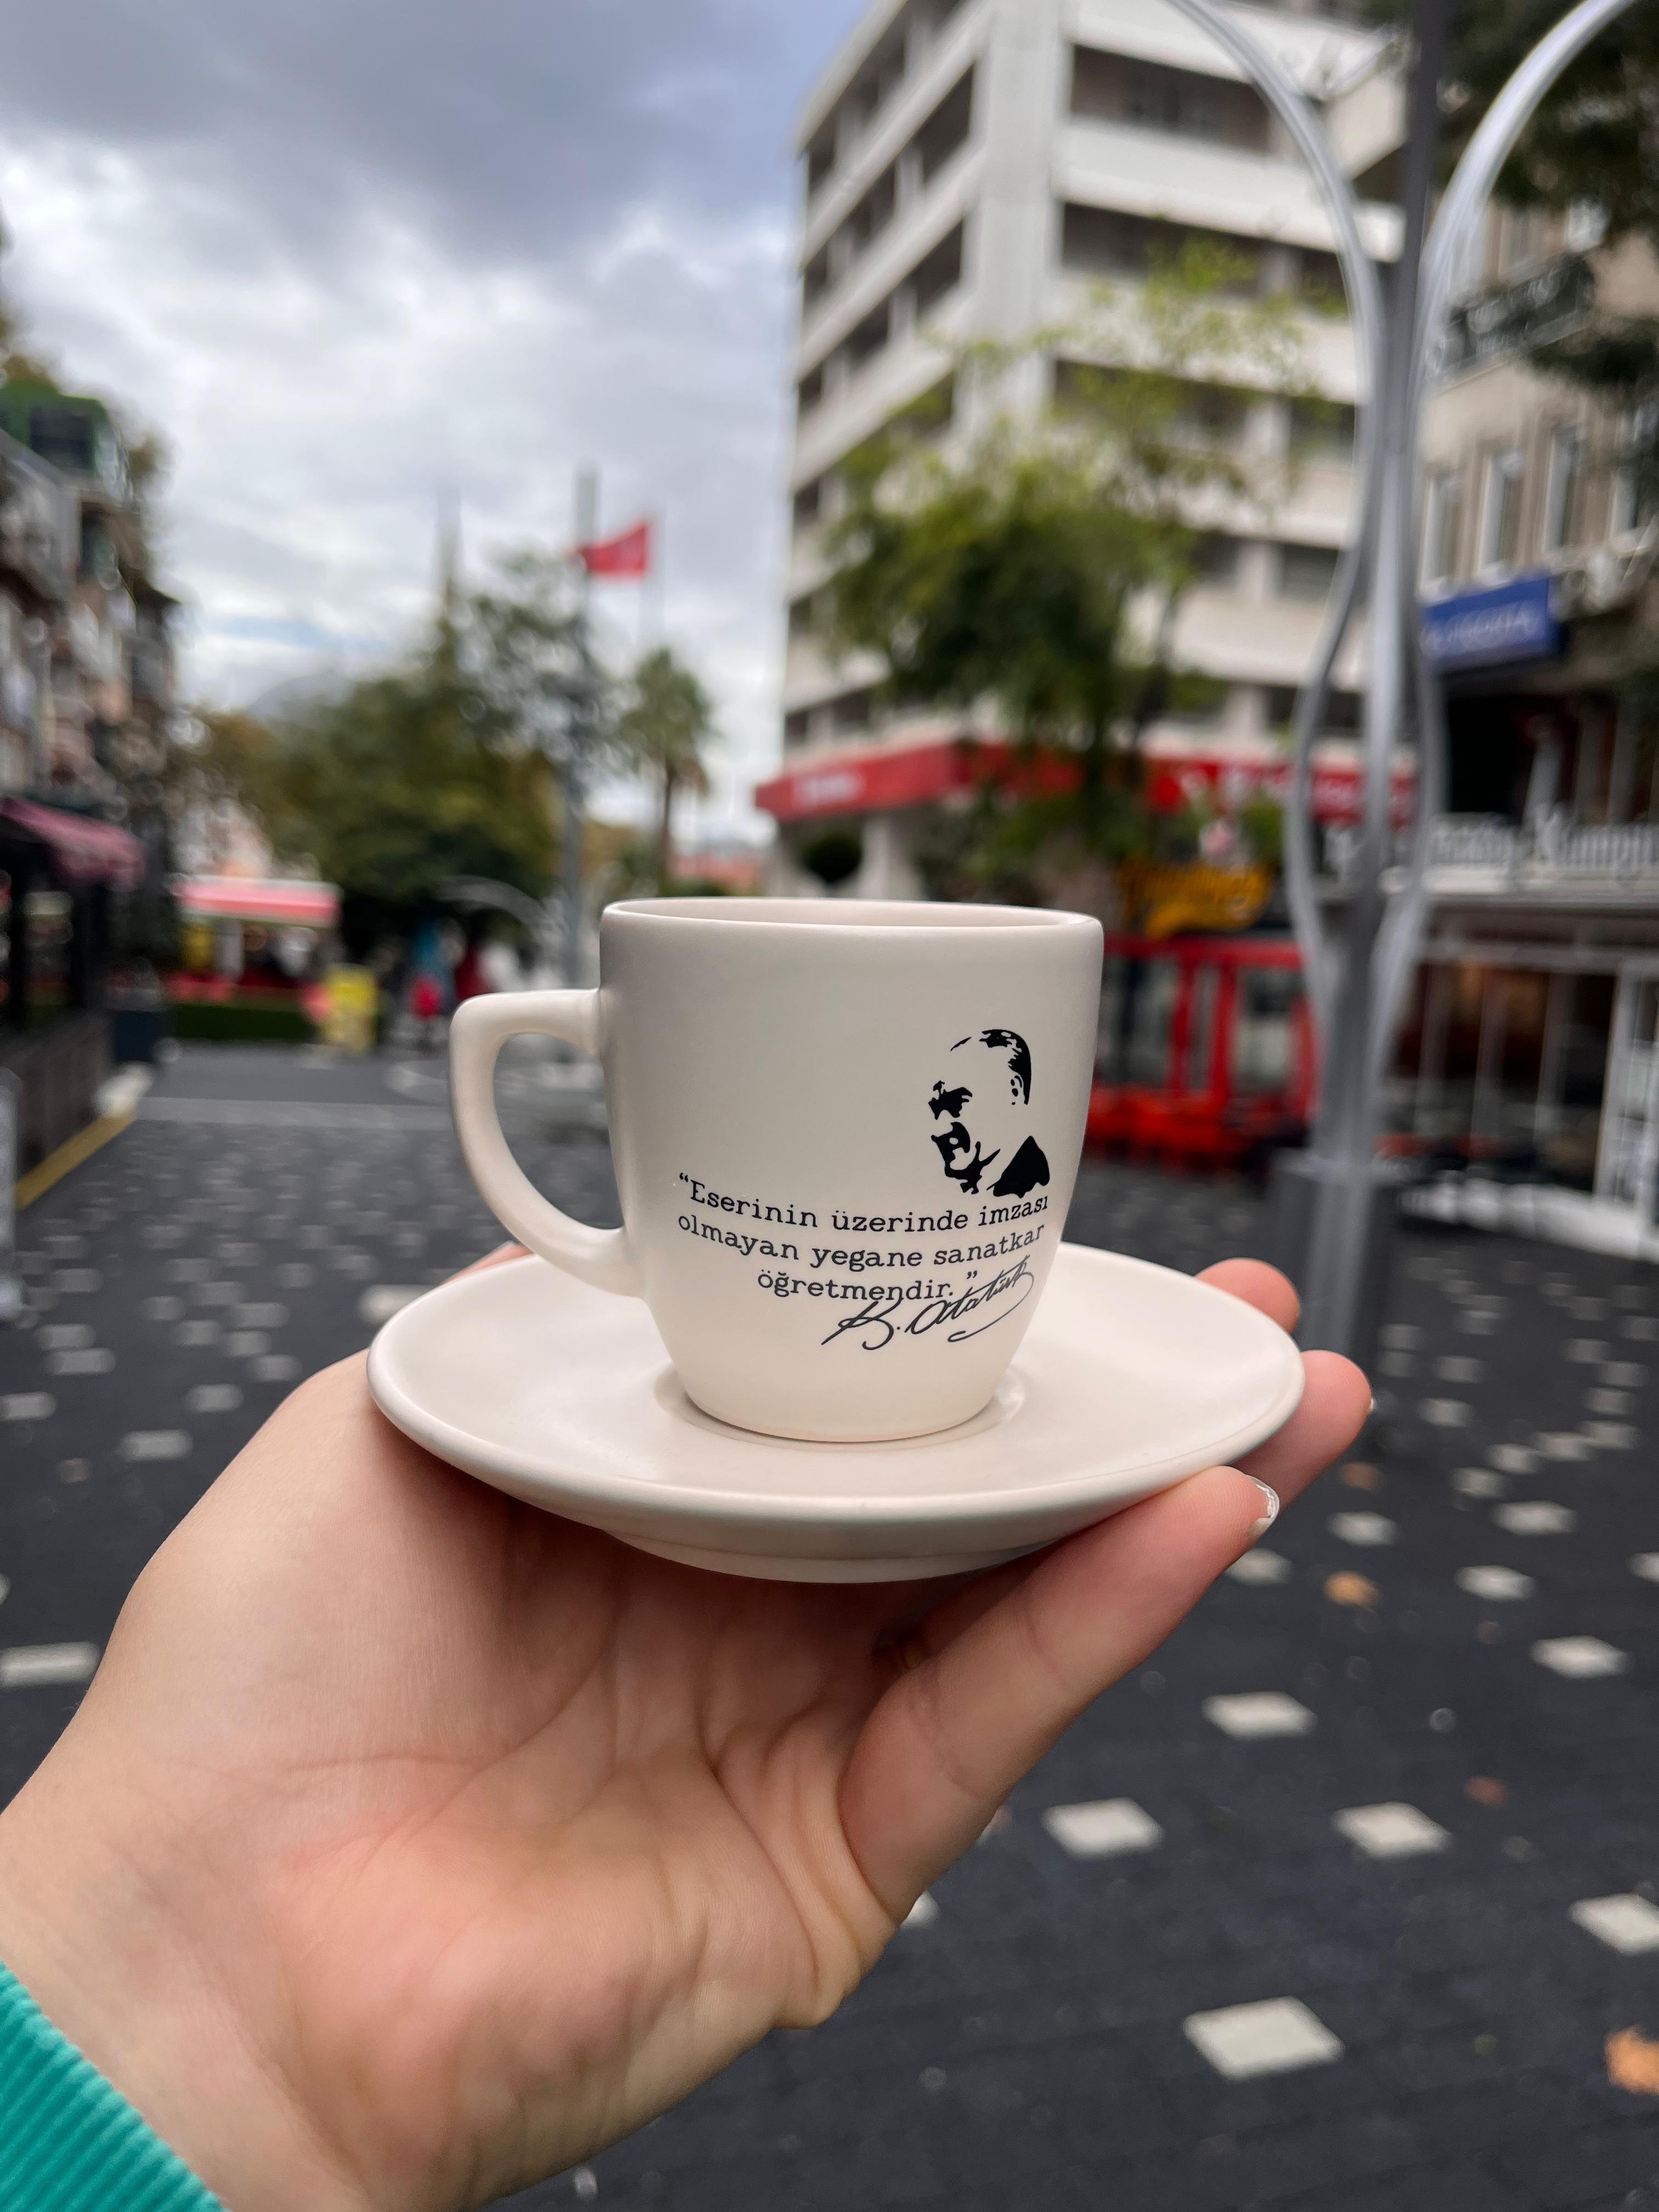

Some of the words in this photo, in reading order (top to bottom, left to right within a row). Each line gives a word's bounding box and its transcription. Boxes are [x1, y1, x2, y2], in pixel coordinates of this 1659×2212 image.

[678, 1172, 818, 1228] “Eserinin
[832, 1210, 969, 1233] üzerinde
[978, 1195, 1049, 1226] imzası
[678, 1214, 799, 1261] olmayan
[810, 1246, 923, 1272] yegane
[933, 1224, 1045, 1265] sanatkar
